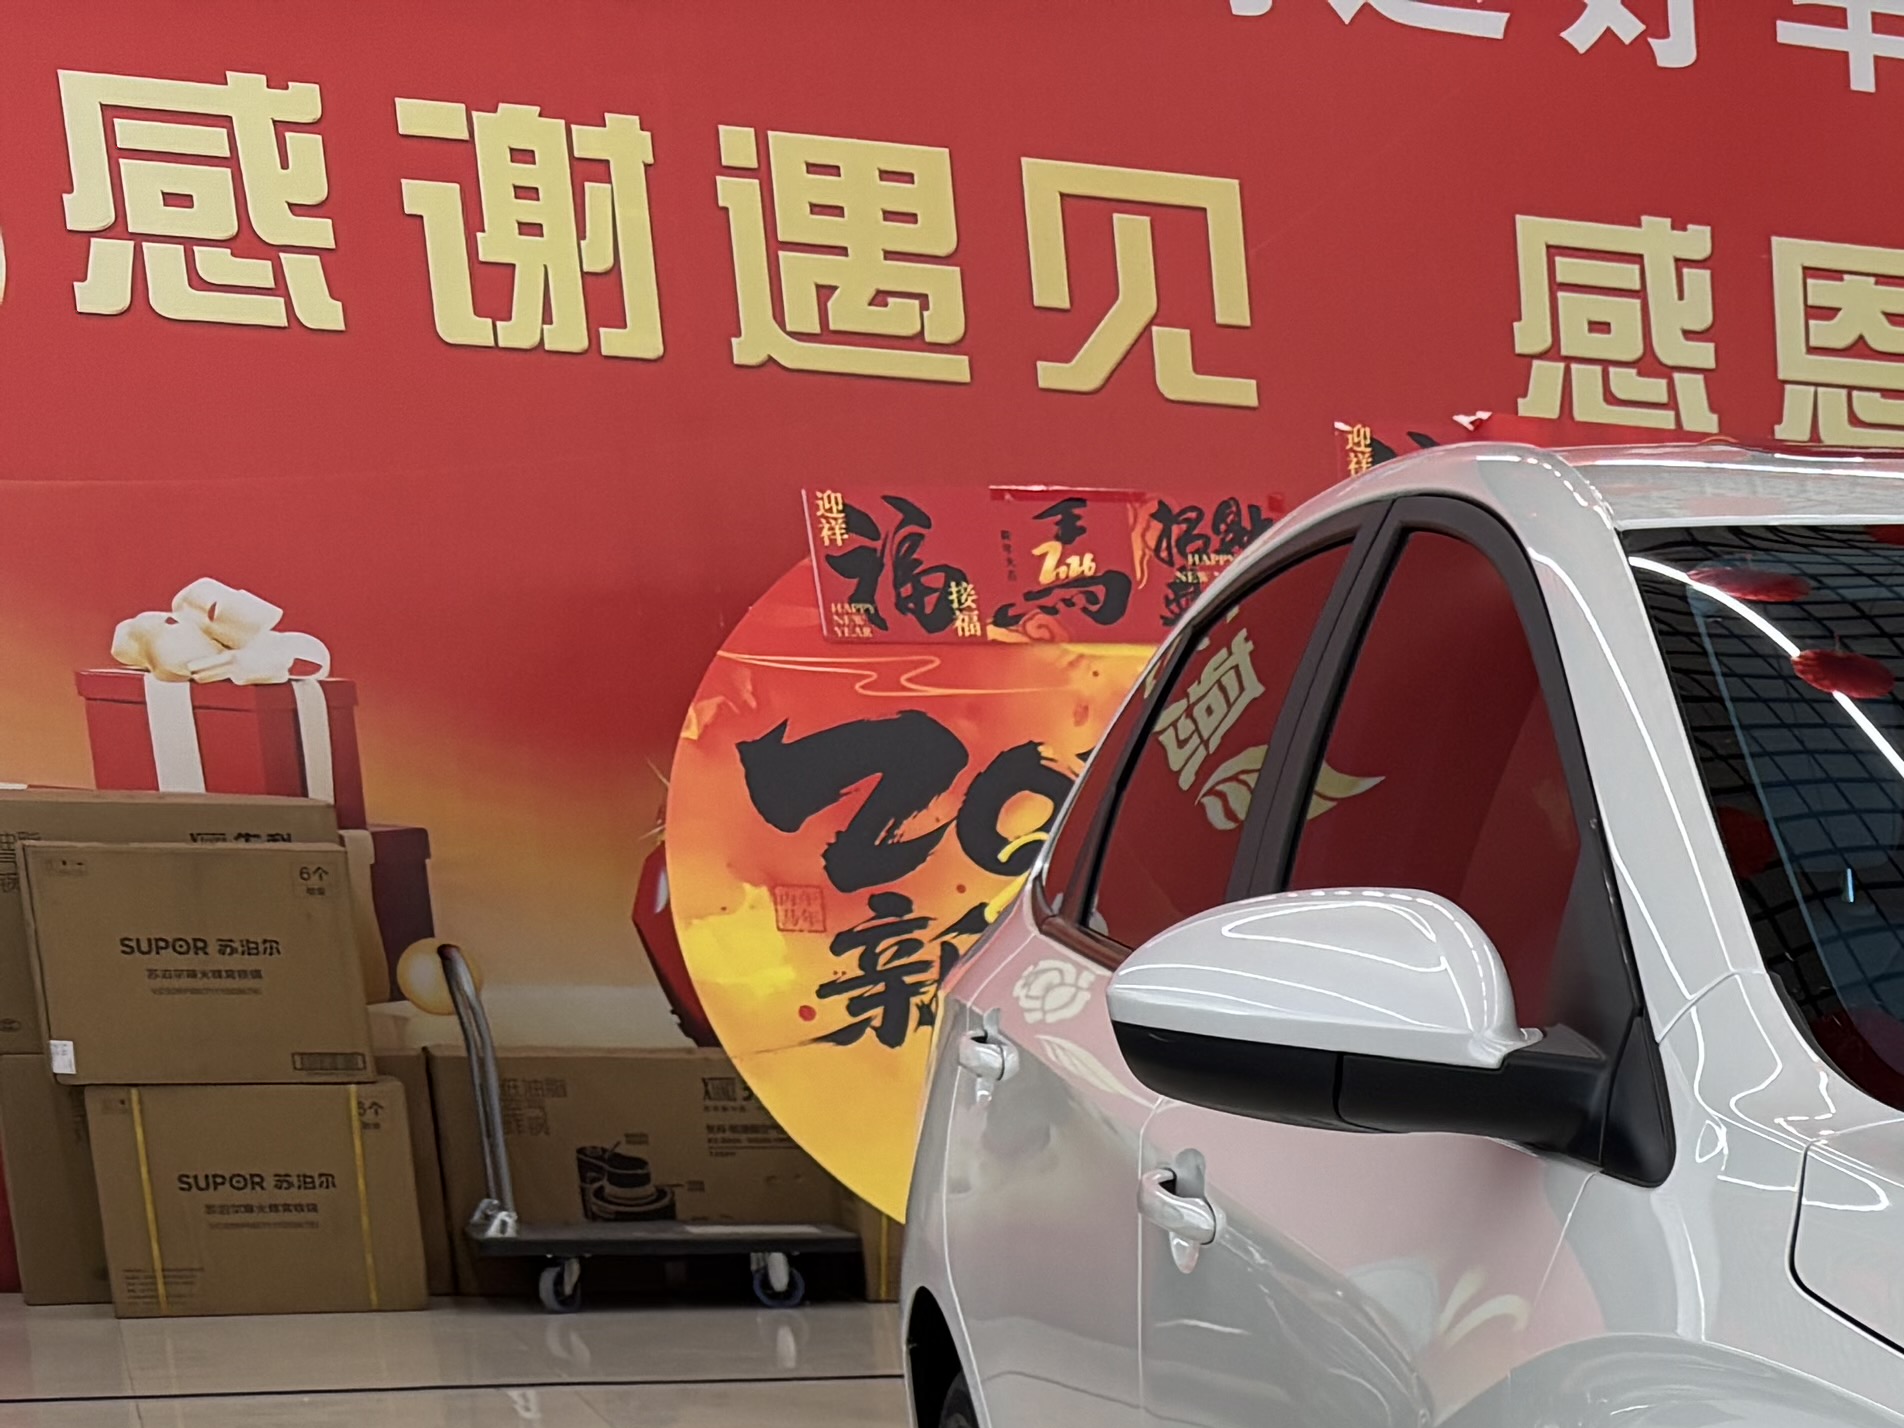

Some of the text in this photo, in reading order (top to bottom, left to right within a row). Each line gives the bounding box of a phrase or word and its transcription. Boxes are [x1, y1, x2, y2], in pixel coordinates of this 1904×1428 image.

[57, 69, 1259, 407] 感谢遇见
[816, 490, 848, 547] 迎祥
[826, 495, 967, 633] 福
[1032, 541, 1096, 584] 2026
[834, 625, 873, 637] YEAR
[949, 581, 981, 637] 接福
[736, 709, 1095, 893] 20
[120, 937, 282, 957] SUPOR 苏泊尔
[177, 1173, 337, 1192] SUPOR 苏泊尔
